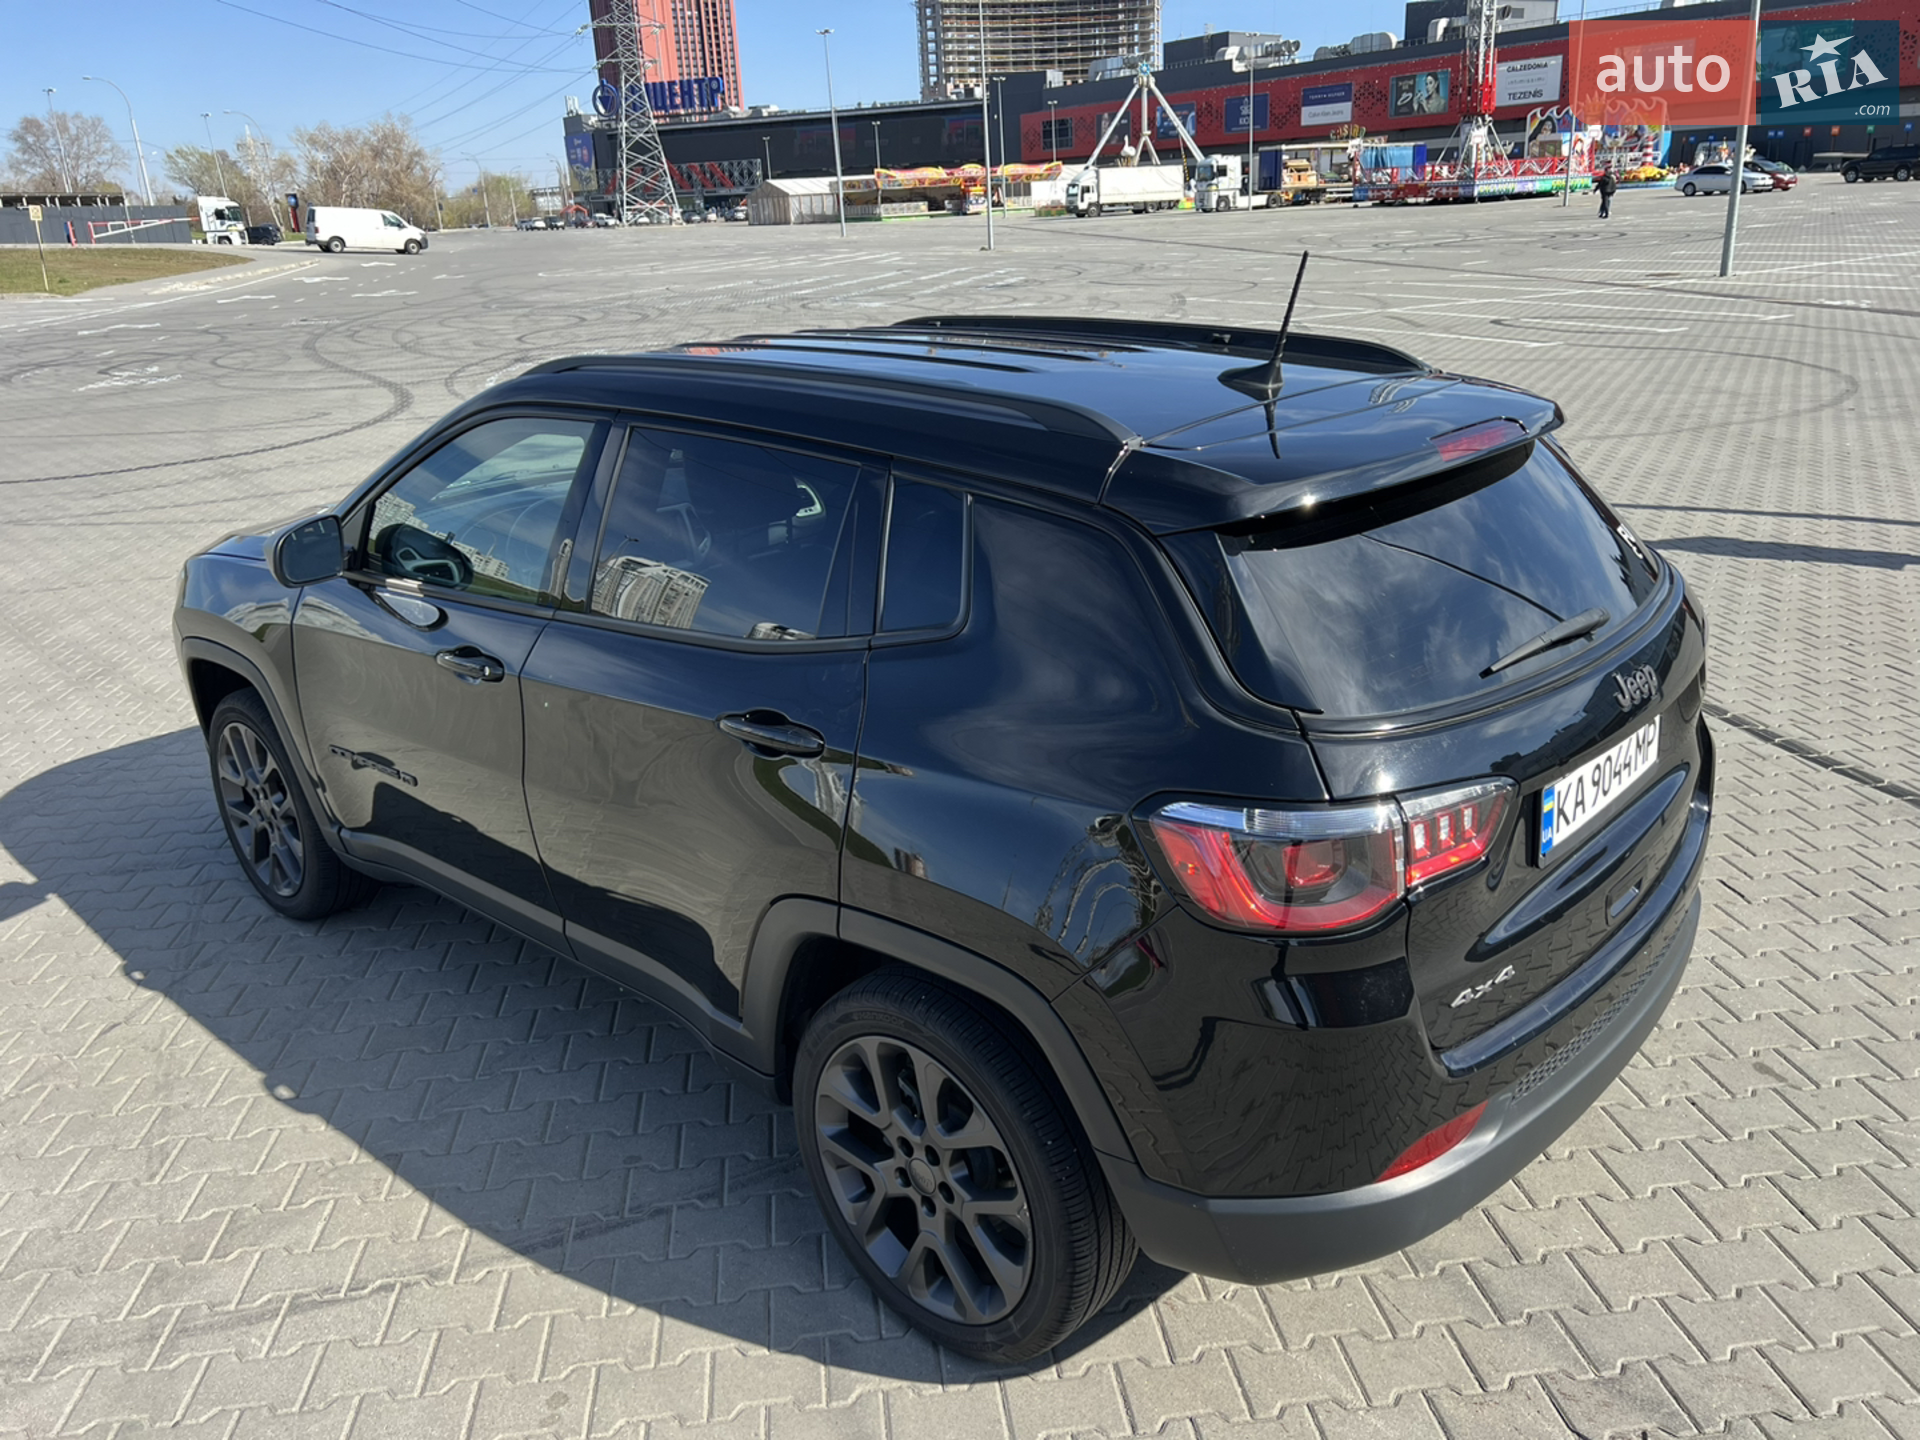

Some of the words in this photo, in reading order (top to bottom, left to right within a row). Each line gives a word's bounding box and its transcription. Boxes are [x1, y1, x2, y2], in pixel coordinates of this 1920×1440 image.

[1507, 62, 1548, 73] CALZEDONIA
[622, 76, 723, 113] ЦЕНТР
[1612, 664, 1659, 713] Jeep
[1556, 775, 1586, 834] KA
[1542, 826, 1553, 843] UA
